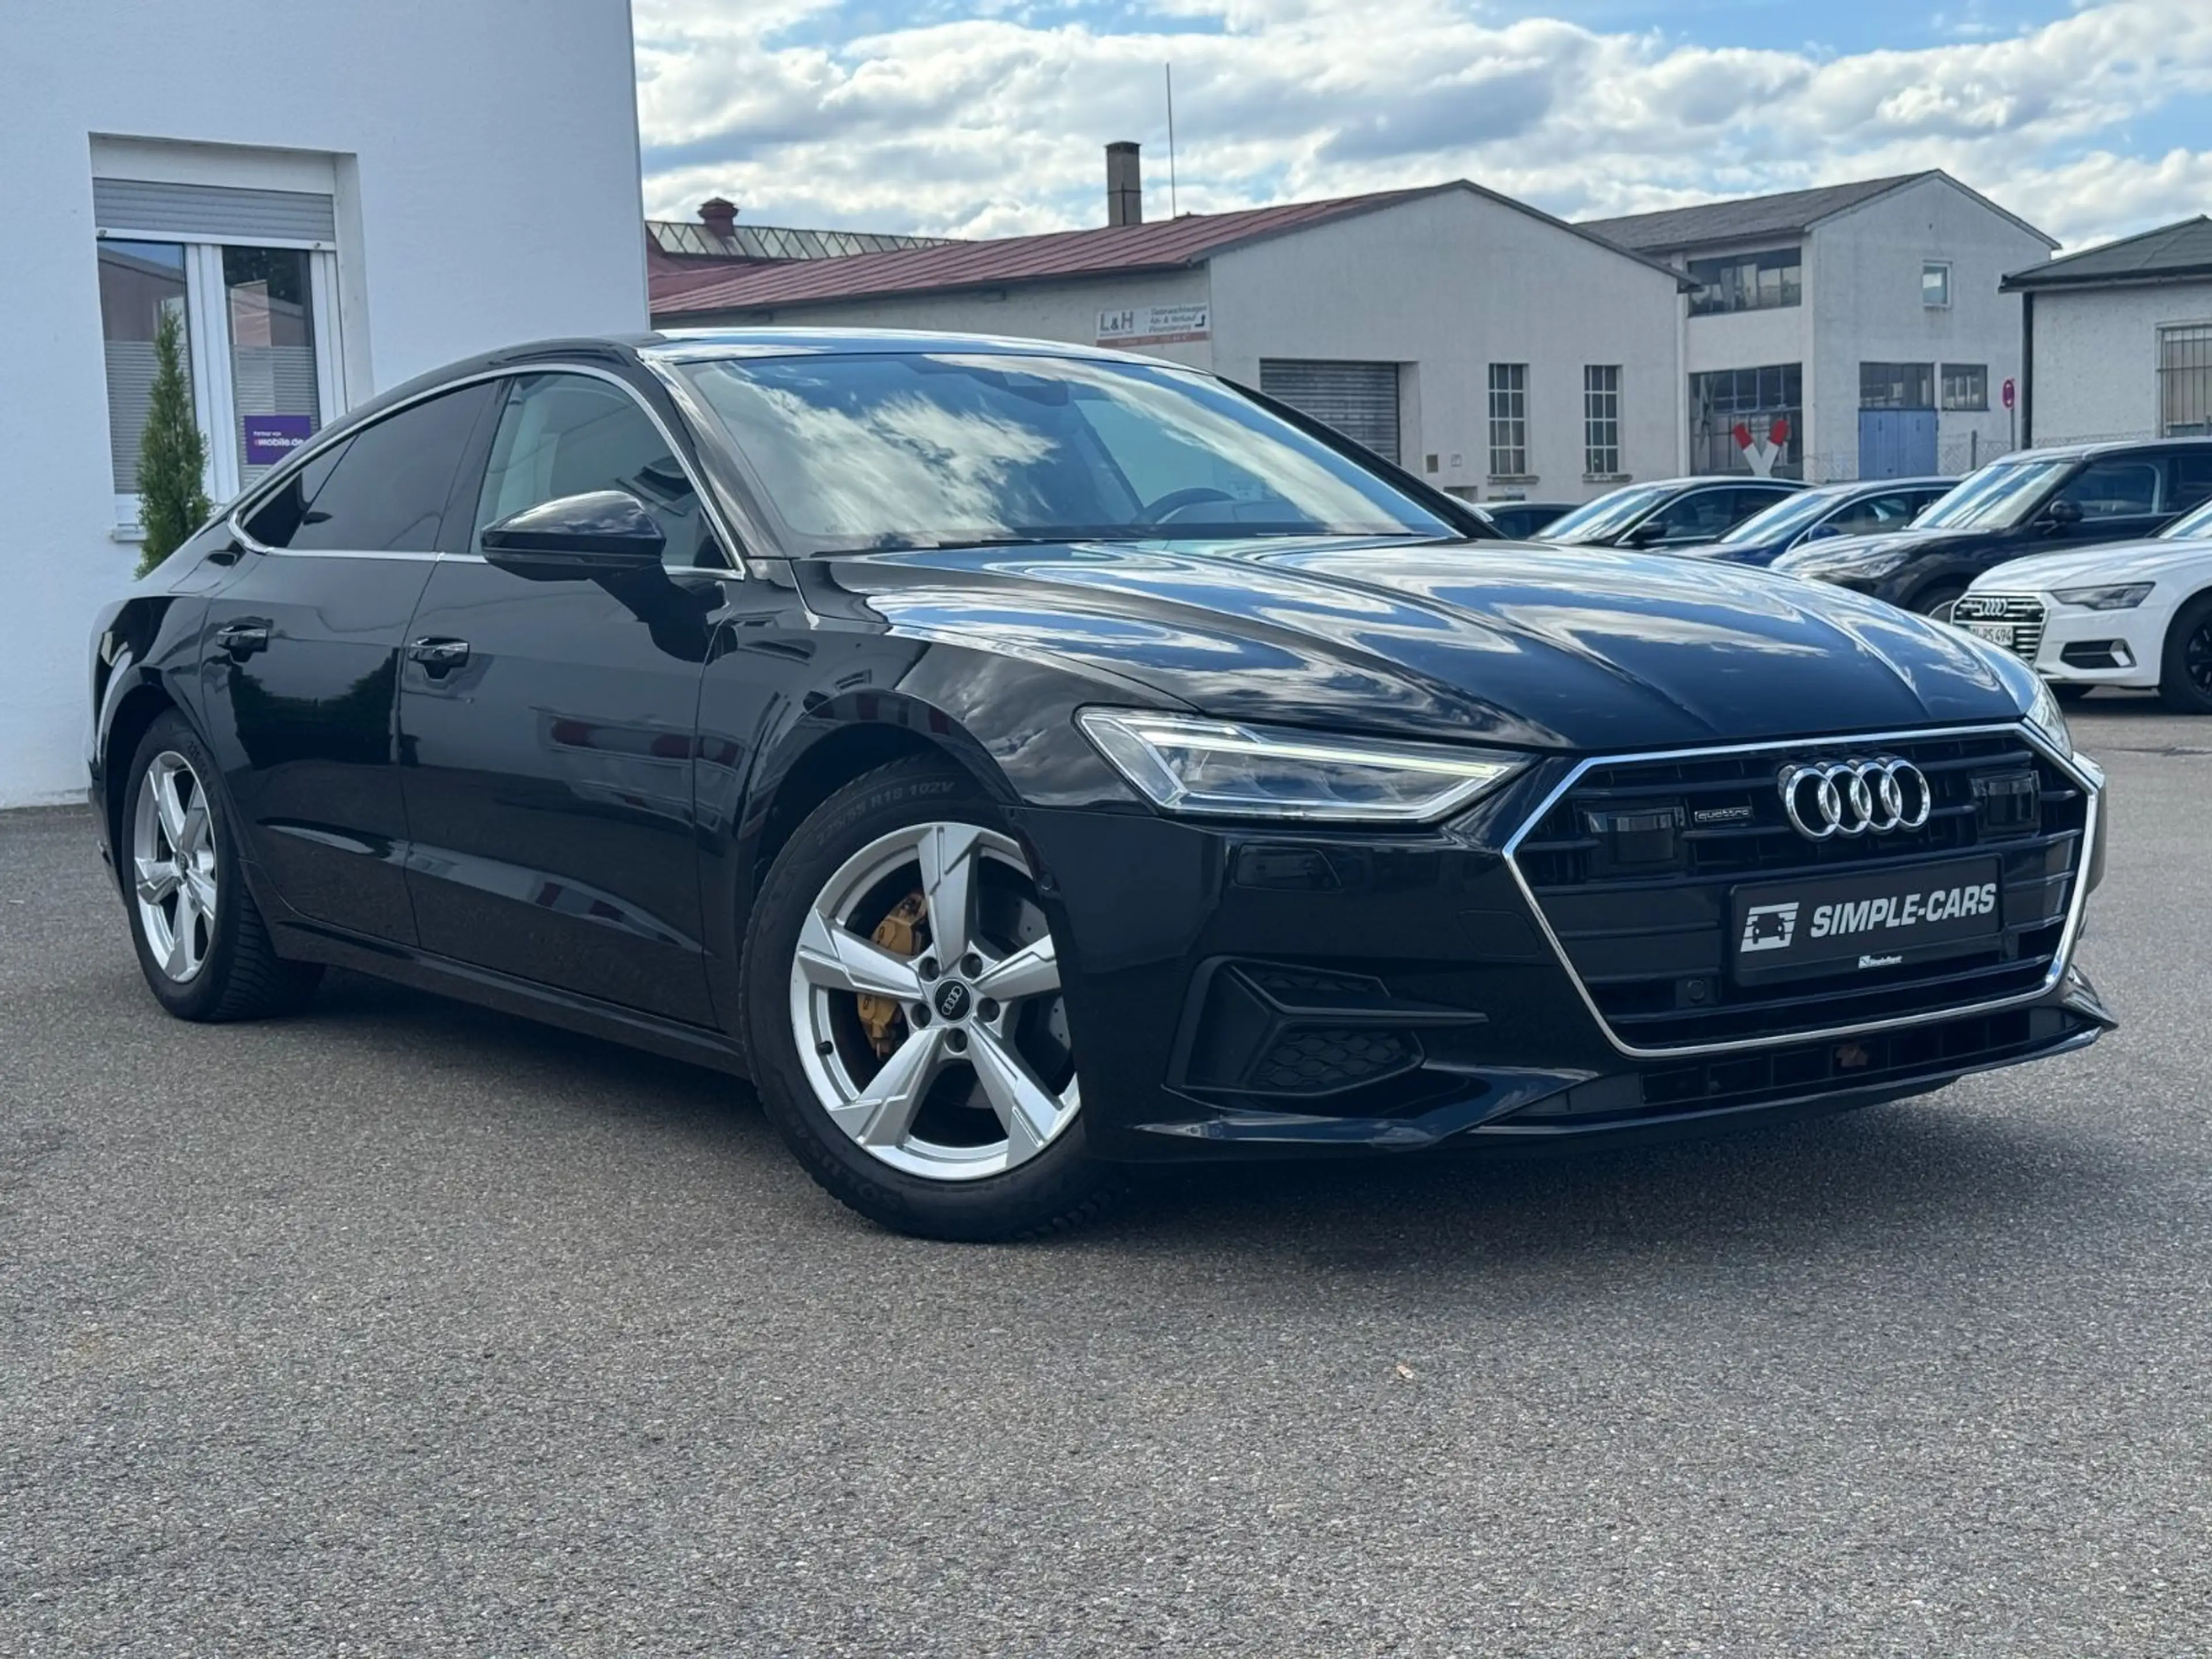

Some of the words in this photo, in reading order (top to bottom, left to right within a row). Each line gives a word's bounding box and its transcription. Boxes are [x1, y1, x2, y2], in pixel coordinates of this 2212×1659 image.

[910, 781, 955, 796] 102V
[1698, 809, 1749, 820] quattro
[1810, 883, 1997, 938] SIMPLE-CARS
